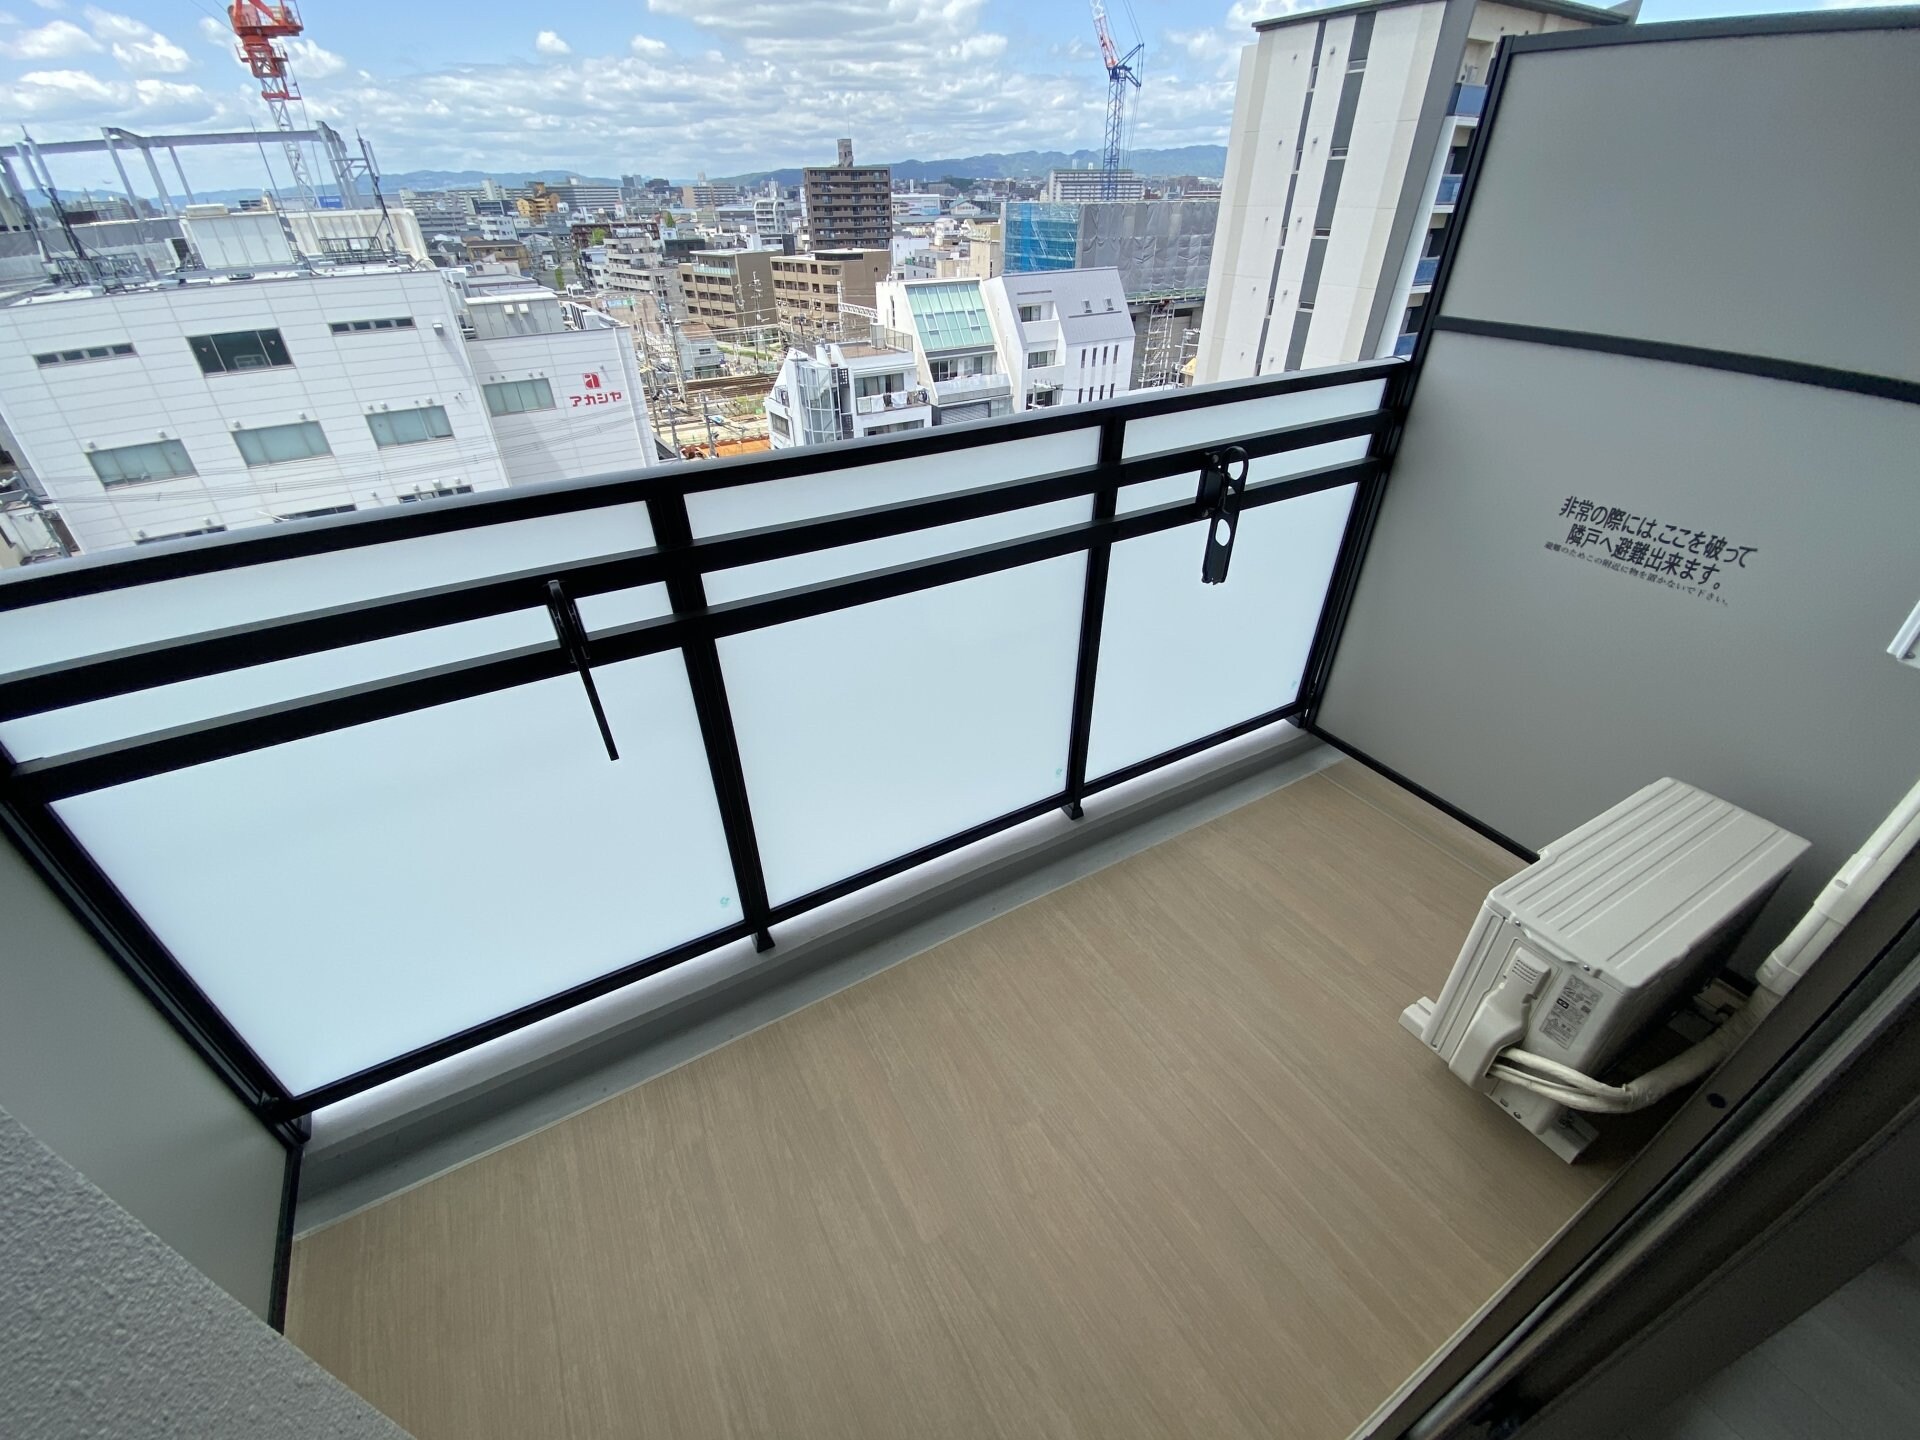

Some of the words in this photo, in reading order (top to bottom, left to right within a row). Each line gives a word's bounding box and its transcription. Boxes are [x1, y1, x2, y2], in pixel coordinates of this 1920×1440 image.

[569, 391, 622, 408] アカシヤ
[1565, 523, 1720, 590] 隣戸へ避難出来ます。
